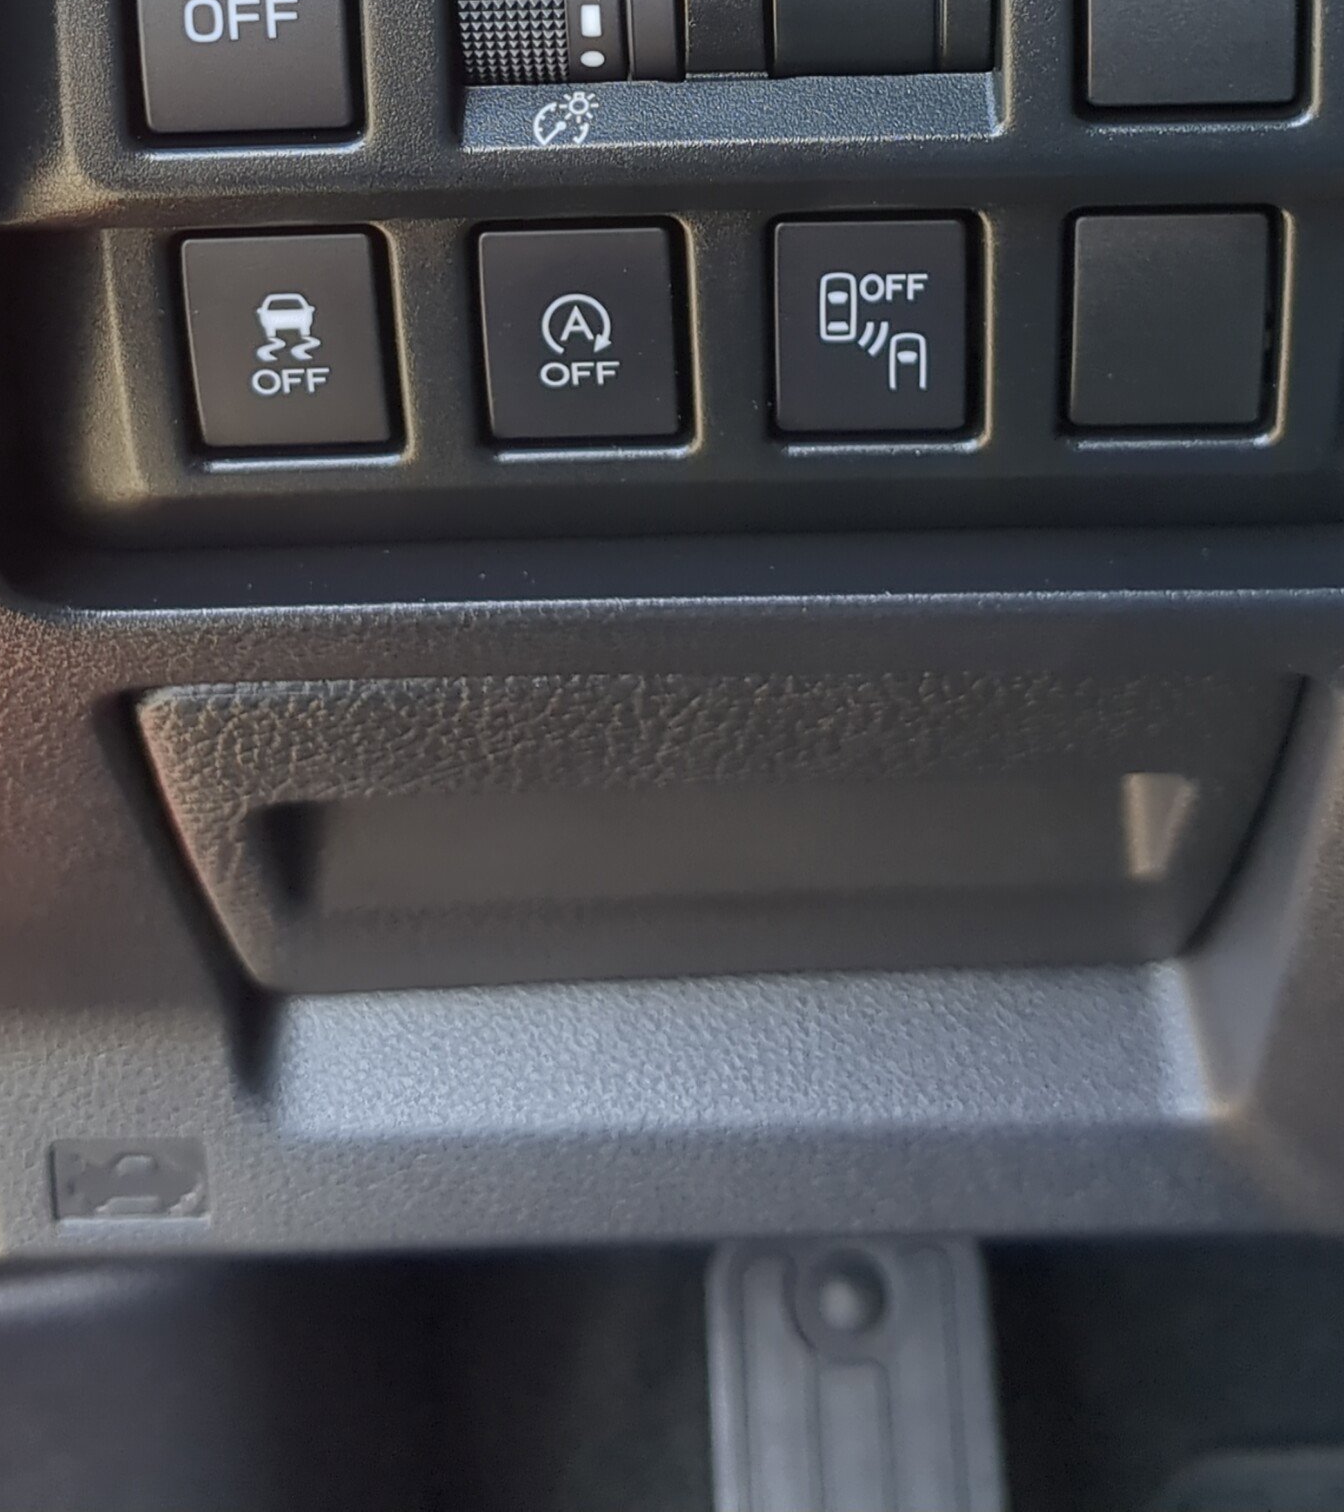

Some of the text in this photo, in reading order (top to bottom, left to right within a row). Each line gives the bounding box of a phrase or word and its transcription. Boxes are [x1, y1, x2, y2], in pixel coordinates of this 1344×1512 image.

[858, 273, 929, 303] OFF
[251, 366, 331, 396] OFF
[538, 360, 620, 388] OFF
